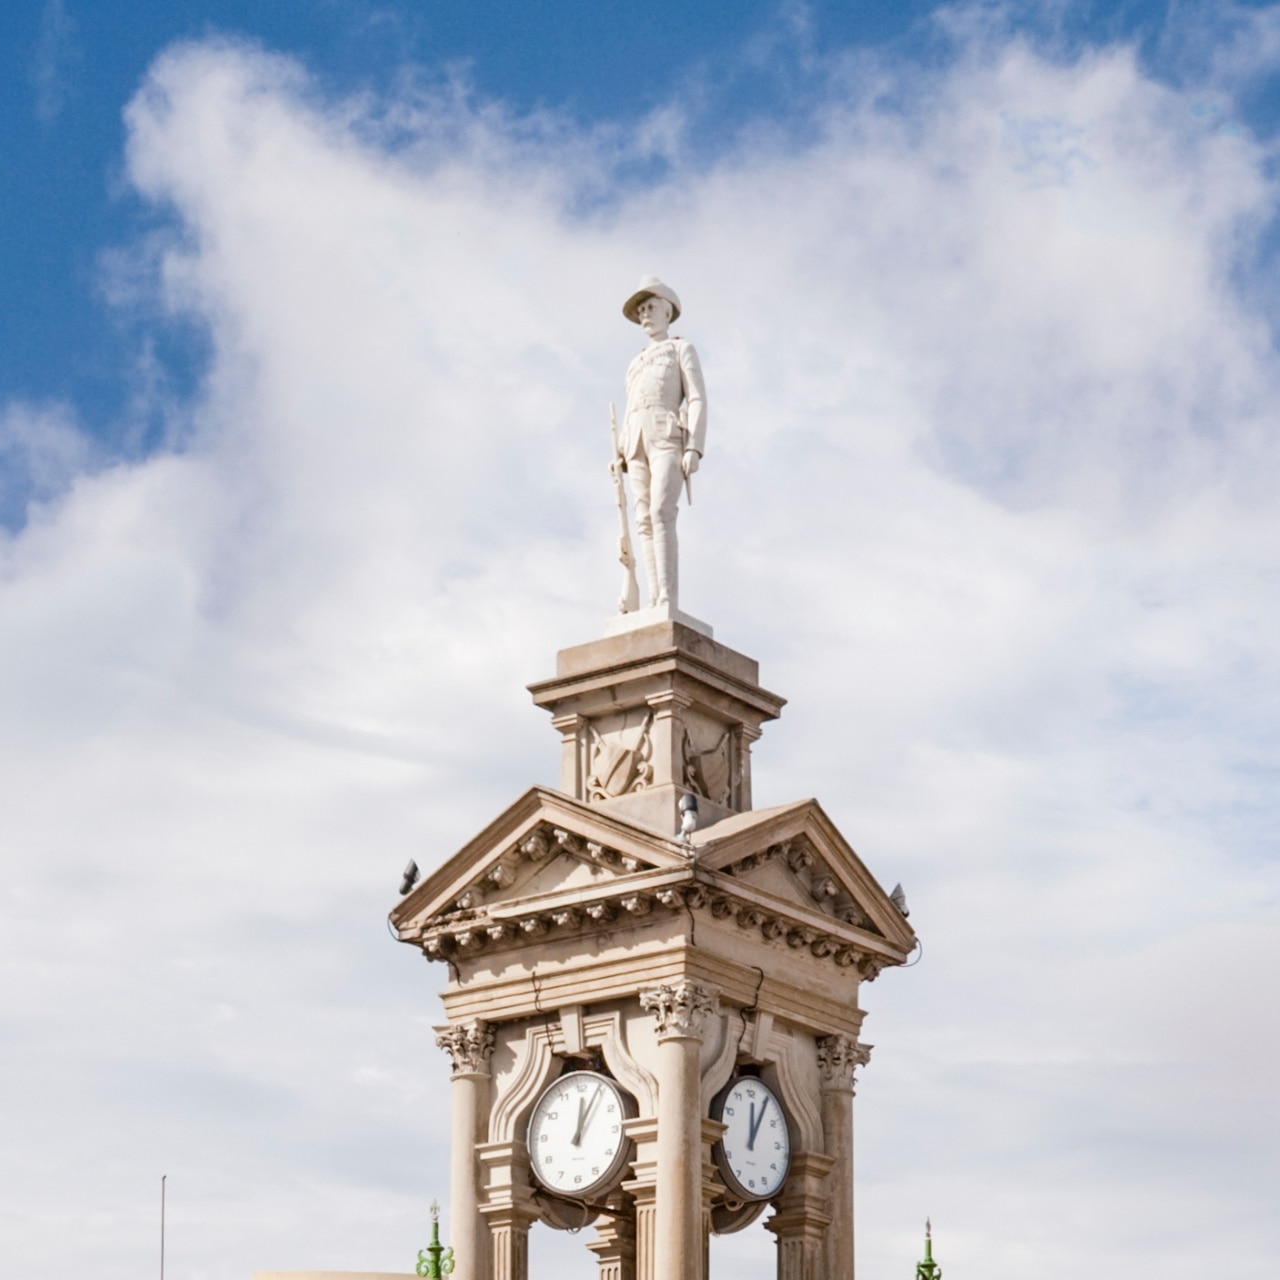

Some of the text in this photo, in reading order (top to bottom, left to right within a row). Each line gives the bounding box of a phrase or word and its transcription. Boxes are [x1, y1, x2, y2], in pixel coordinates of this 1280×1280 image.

[576, 1084, 587, 1092] 12
[560, 1093, 569, 1101] 11
[607, 1104, 615, 1112] 2
[546, 1112, 558, 1120] 10
[612, 1125, 619, 1133] 3
[541, 1134, 548, 1142] 9
[774, 1141, 781, 1150] 3
[545, 1156, 553, 1164] 8
[558, 1171, 564, 1179] 7
[592, 1167, 600, 1175] 5
[574, 1175, 582, 1183] 6
